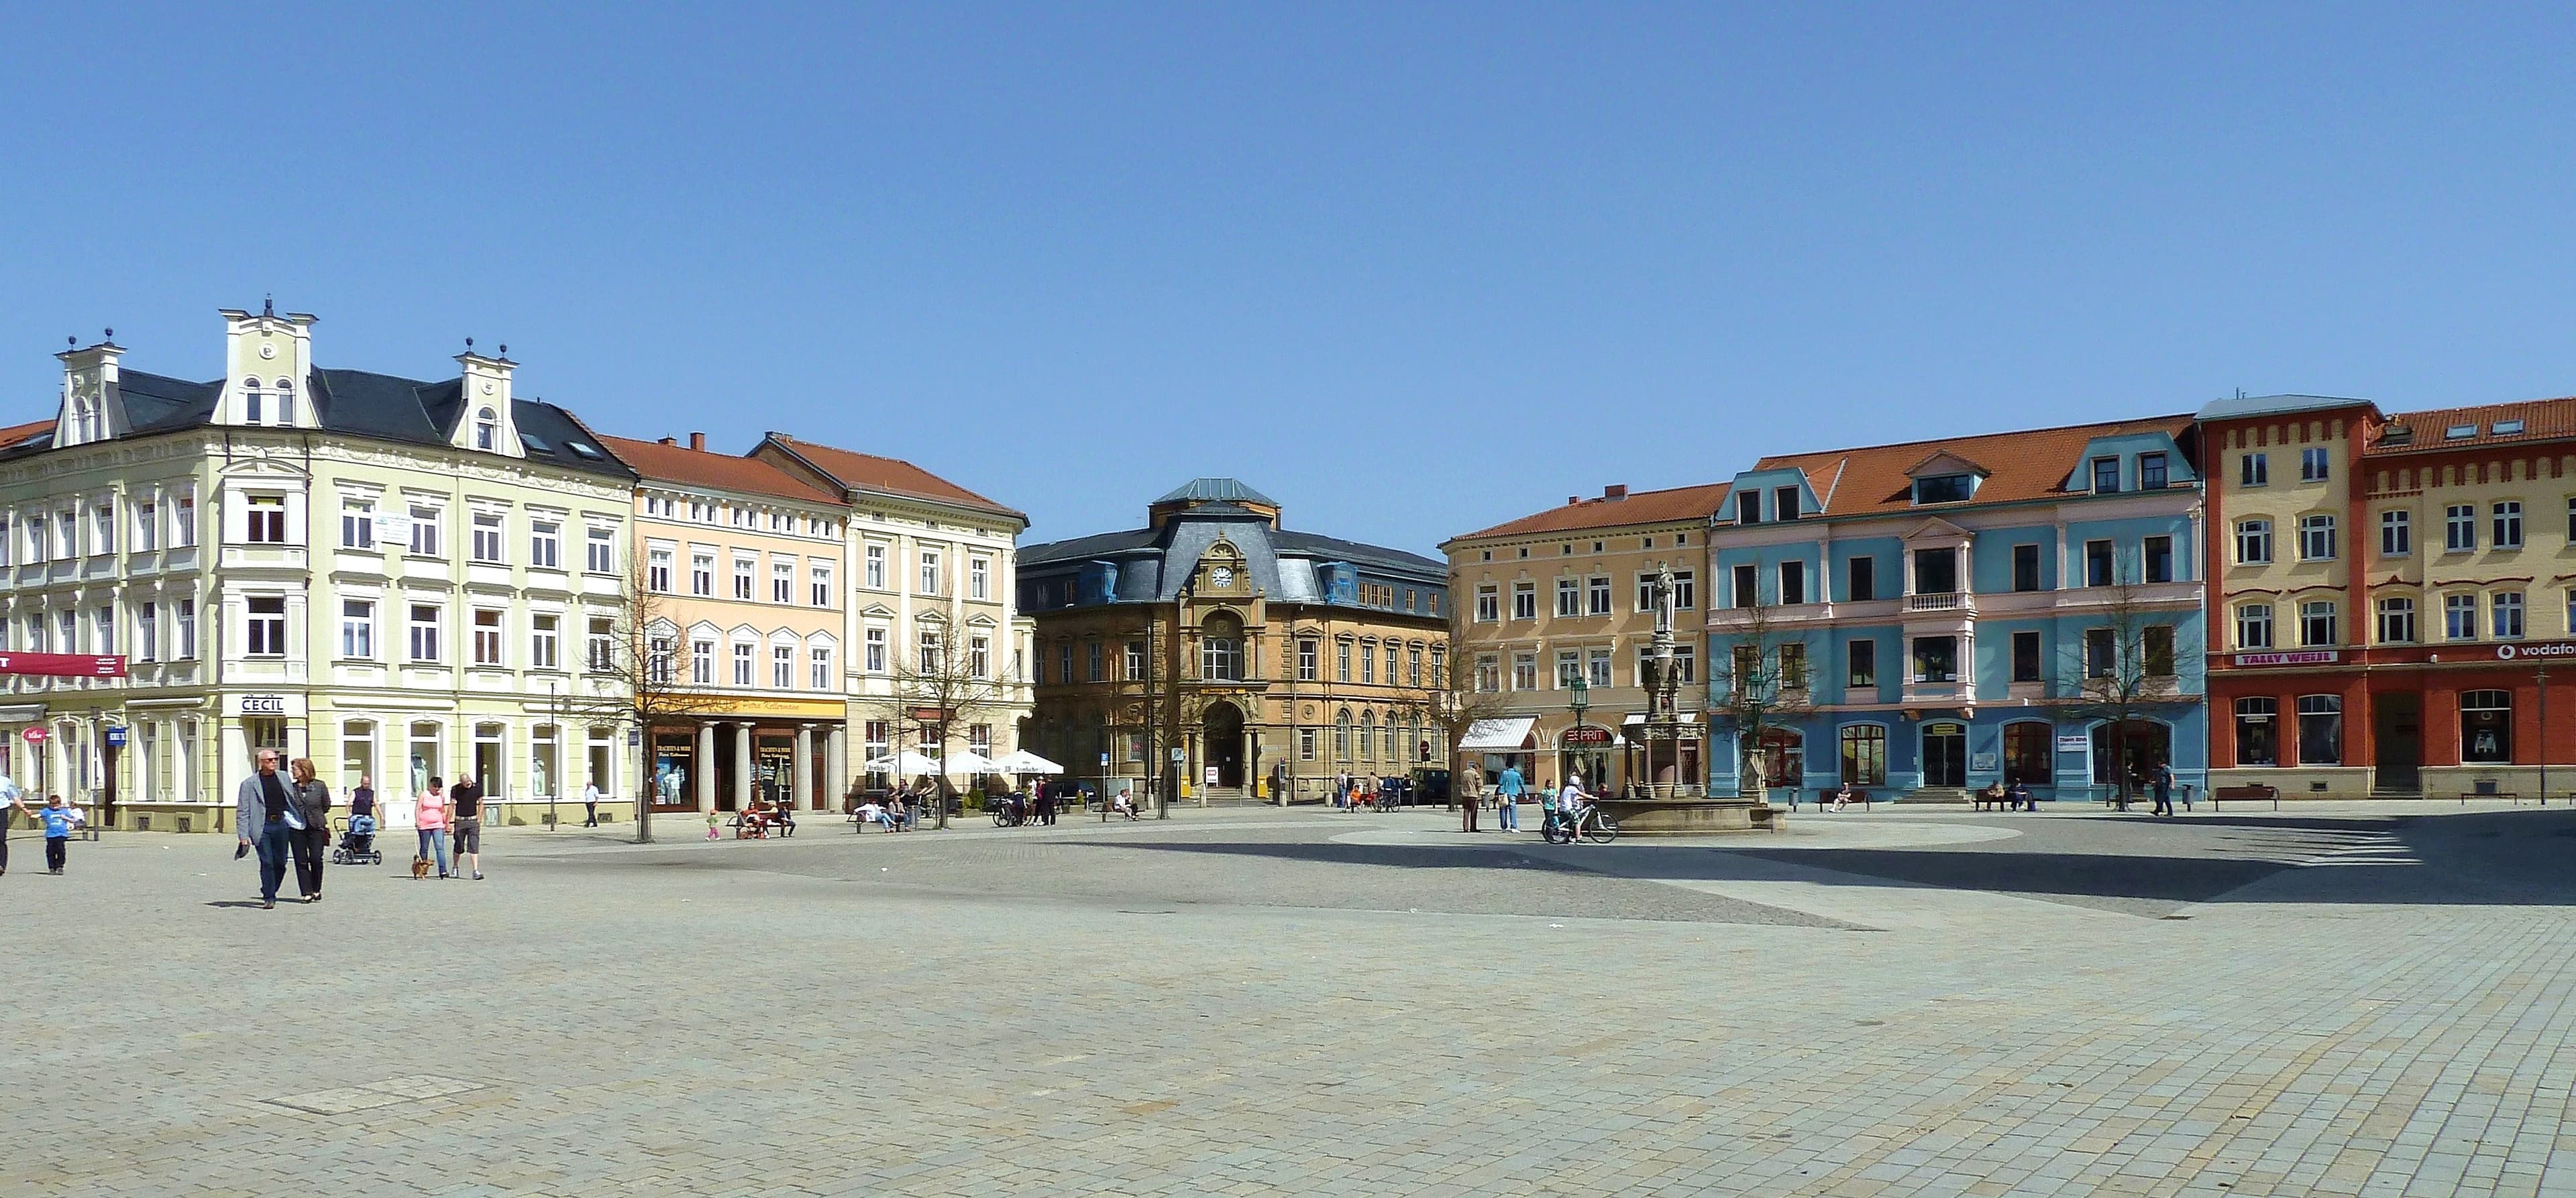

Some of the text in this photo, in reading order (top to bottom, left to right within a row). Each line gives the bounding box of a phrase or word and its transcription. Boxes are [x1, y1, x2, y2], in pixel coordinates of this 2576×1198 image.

[2521, 643, 2576, 655] vodafo
[2242, 654, 2282, 664] TALLY
[242, 700, 284, 710] CECIL
[1567, 730, 1604, 741] ESPRIT
